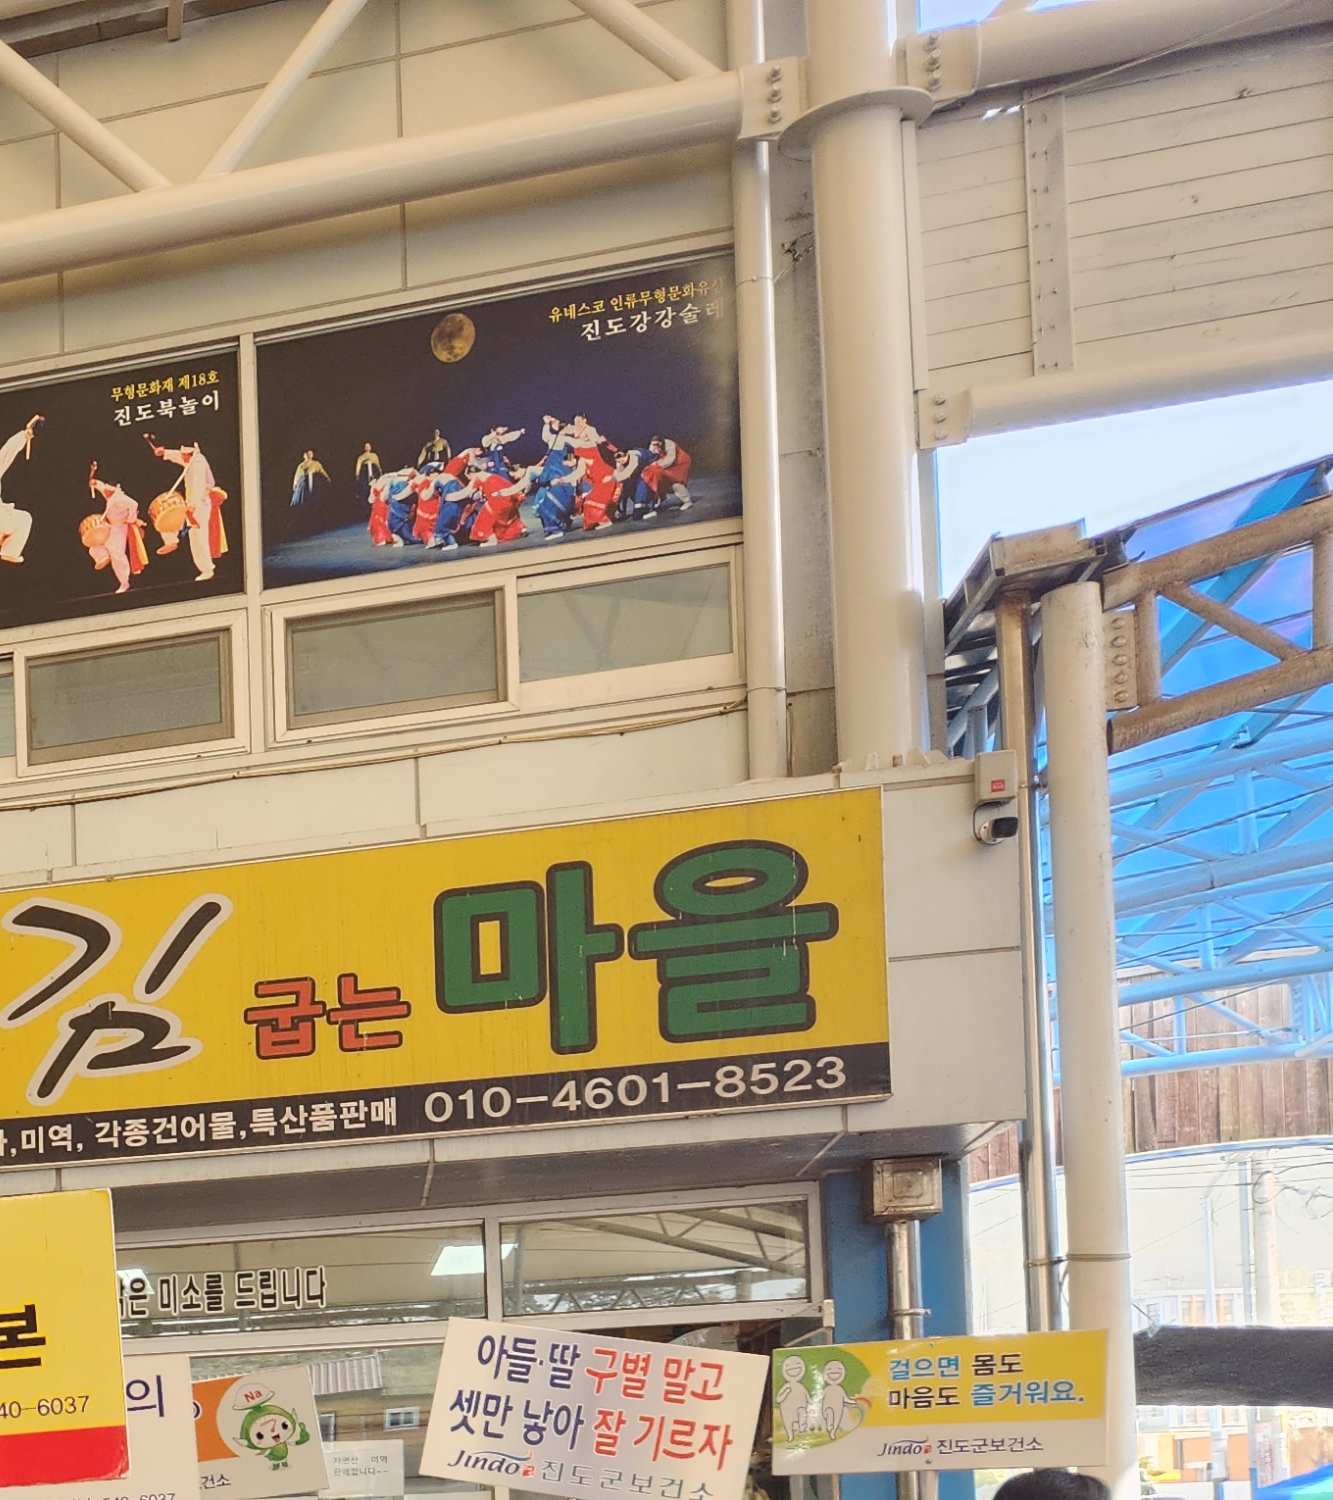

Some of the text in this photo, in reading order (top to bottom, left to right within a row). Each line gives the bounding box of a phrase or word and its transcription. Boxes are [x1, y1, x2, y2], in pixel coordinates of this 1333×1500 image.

[549, 300, 606, 322] 유네스코
[110, 370, 220, 402] 무형문화재 제18호
[113, 390, 219, 426] 진도북놀이
[243, 972, 412, 1060] 굽는
[434, 838, 838, 1055] 마을
[94, 1096, 398, 1153] 각종건어물,특산품판매
[424, 1055, 847, 1123] 010-4601-8523
[158, 1273, 225, 1315] 미소를
[234, 1265, 327, 1309] 드립니다
[585, 1347, 652, 1401] 구별
[662, 1355, 726, 1404] 말고
[888, 1353, 1024, 1381] 걸으면 몸도
[244, 1388, 264, 1403] Na
[888, 1379, 1085, 1410] 마음도 즐거워요.
[449, 1388, 733, 1472] 셋만 낳아 잘 기르자
[878, 1436, 1044, 1457] Jindo 진도군보건소
[447, 1449, 520, 1477] Jindo
[198, 1473, 232, 1490] 건소
